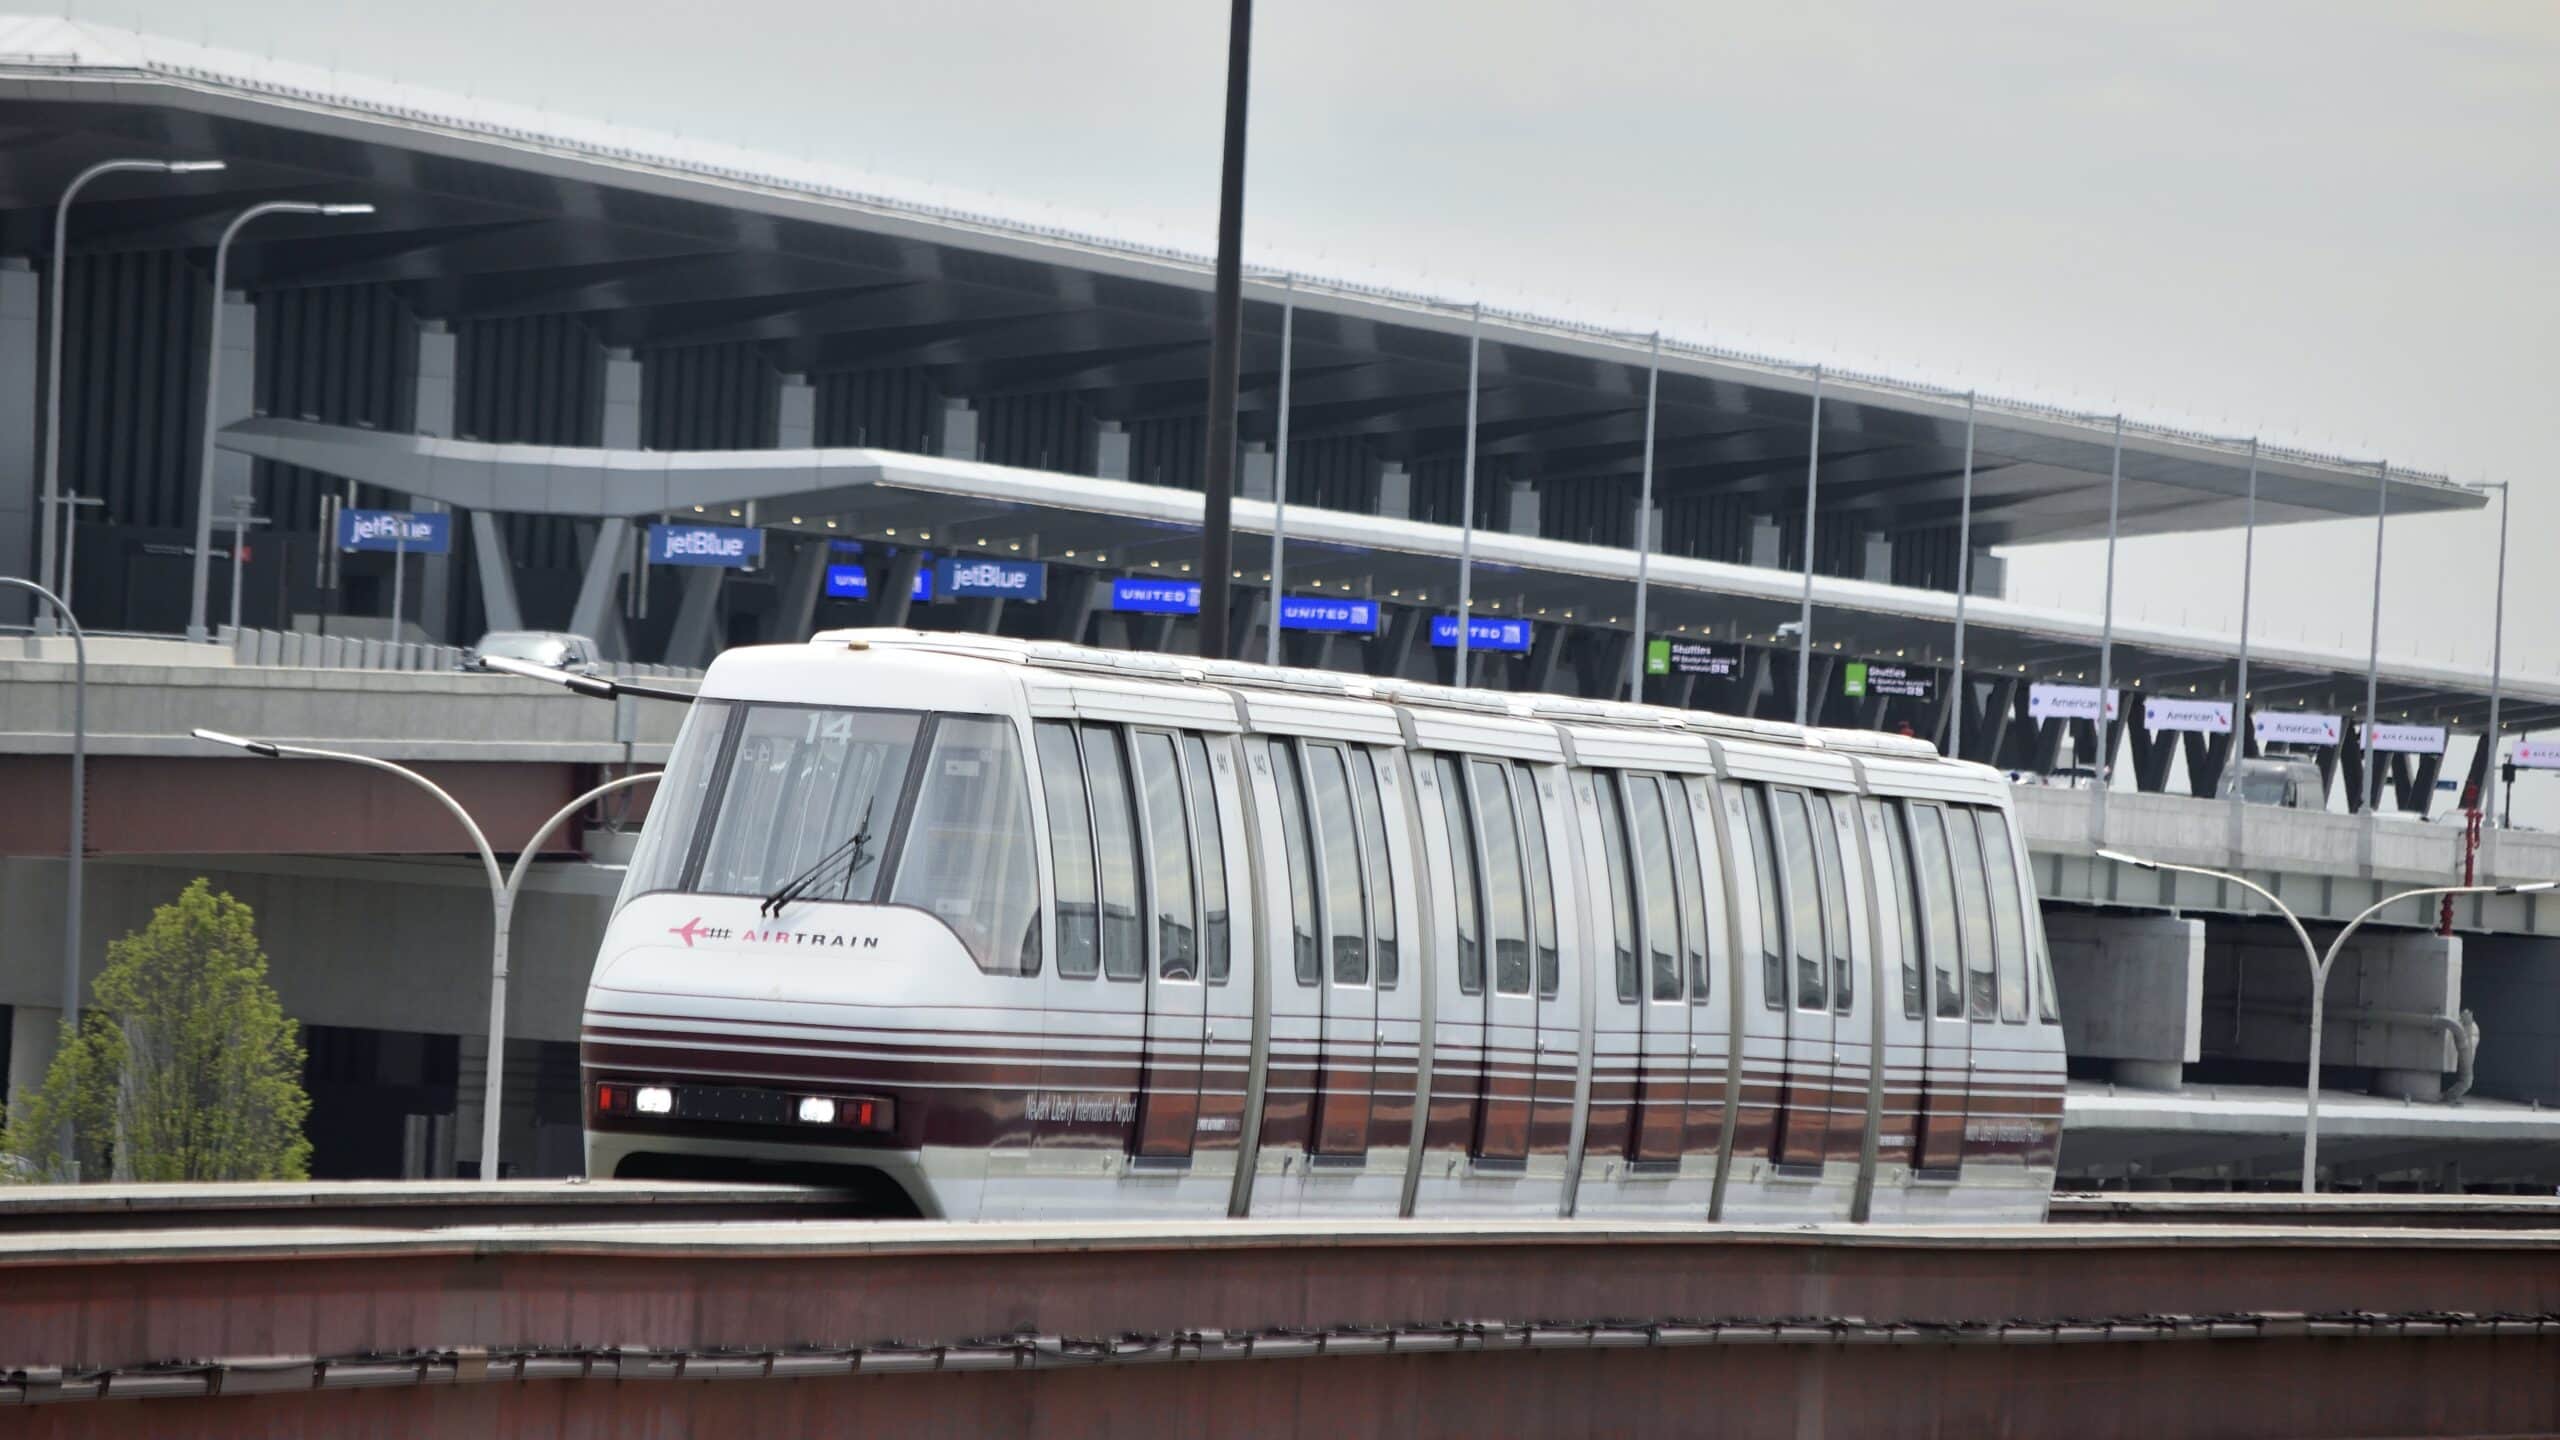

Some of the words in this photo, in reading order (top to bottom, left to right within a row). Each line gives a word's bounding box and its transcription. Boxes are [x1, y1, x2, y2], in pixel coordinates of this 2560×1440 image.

[663, 530, 744, 558] jetBlue
[952, 563, 1027, 590] jetBlue
[1120, 589, 1186, 602] UNITED
[1285, 606, 1349, 620] UNITED
[2051, 697, 2097, 709] American
[2166, 711, 2214, 722] American
[804, 712, 854, 746] 14
[2275, 723, 2322, 735] American
[743, 929, 879, 949] AIRTRAIN
[1025, 1094, 1050, 1120] Newark
[1051, 1095, 1073, 1127] Liberty
[1075, 1095, 1114, 1122] International
[1114, 1095, 1138, 1128] Airport
